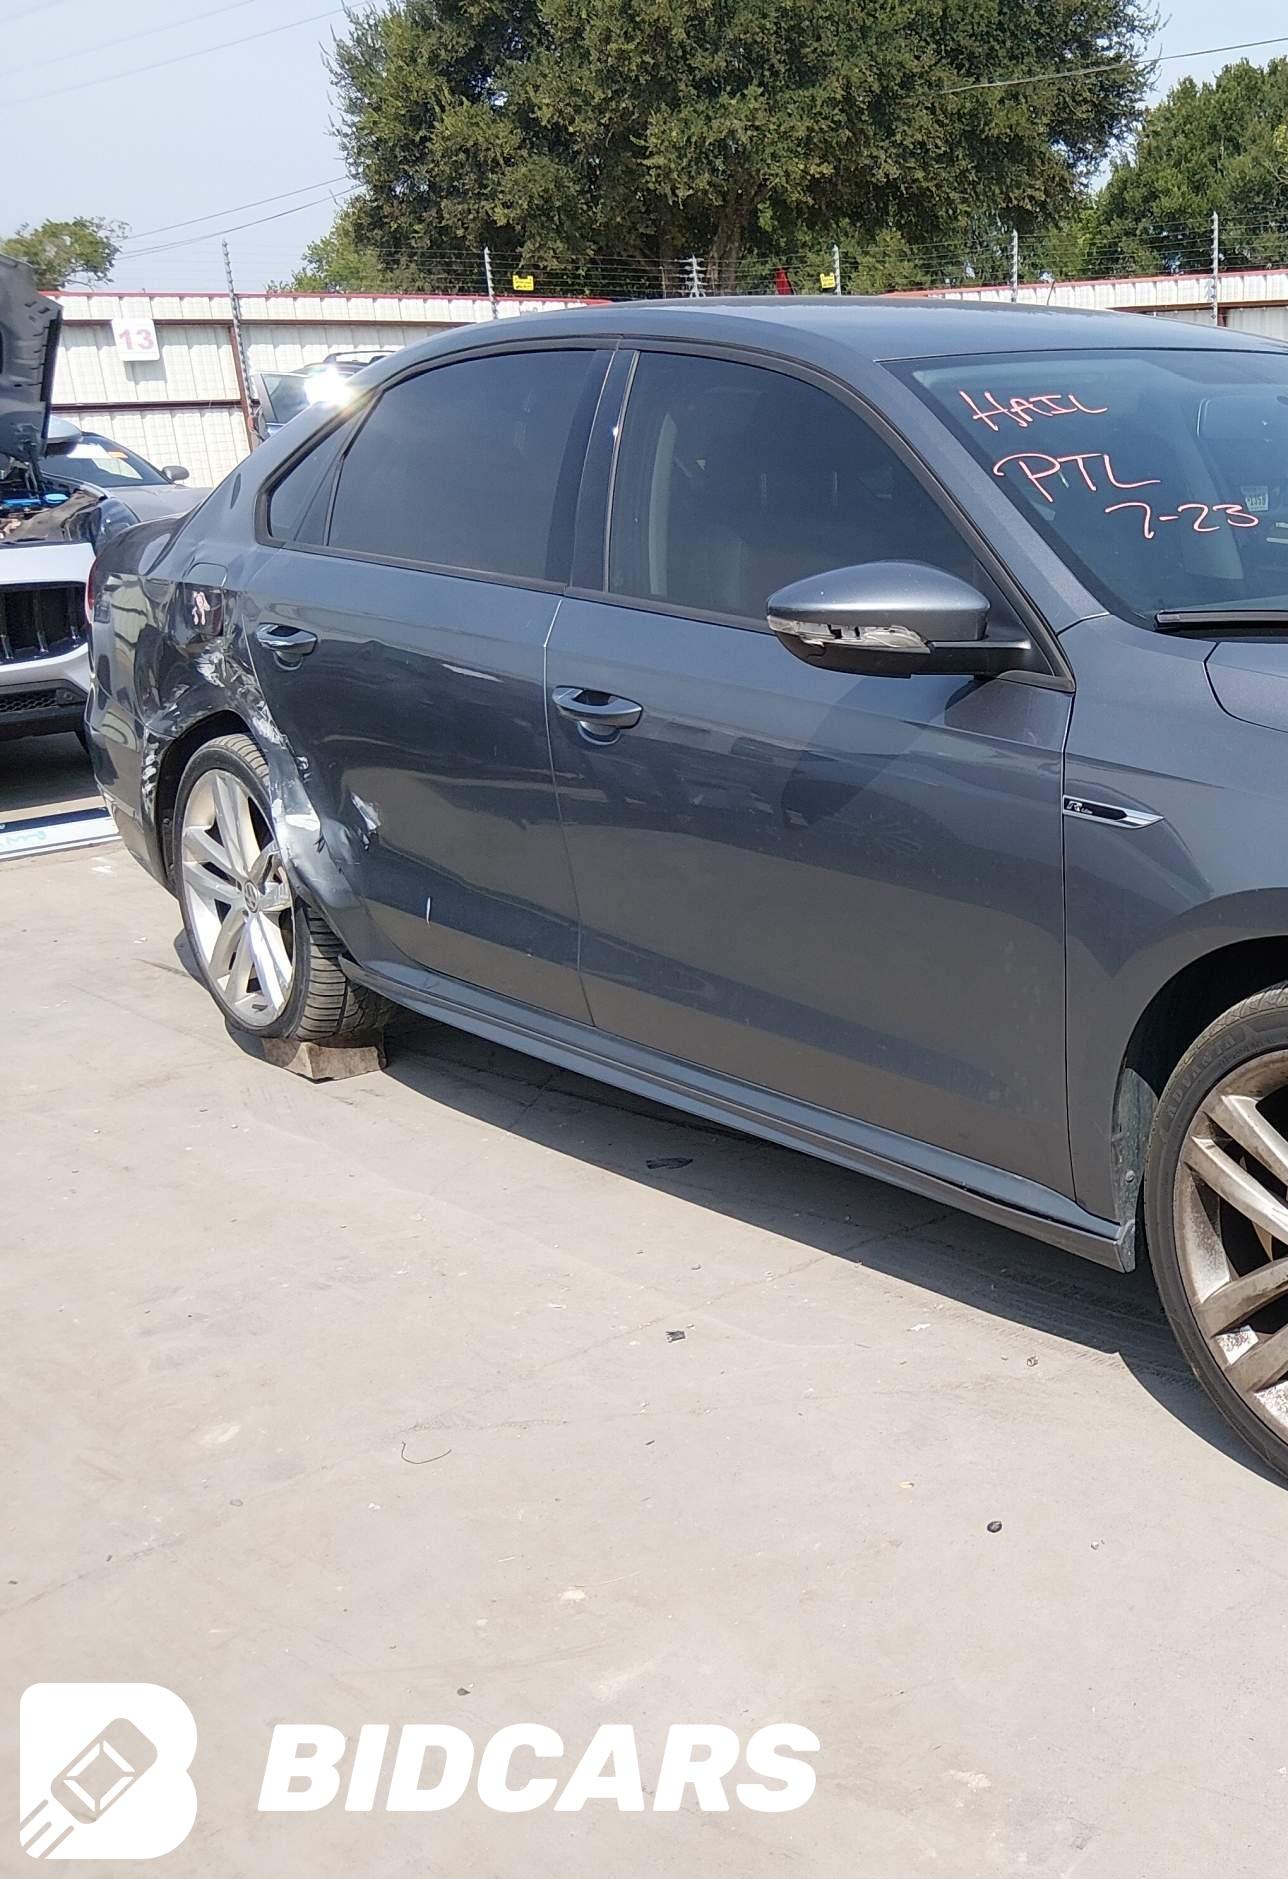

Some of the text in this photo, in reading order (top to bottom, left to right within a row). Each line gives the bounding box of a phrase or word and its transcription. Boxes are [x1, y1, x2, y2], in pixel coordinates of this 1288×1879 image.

[118, 328, 154, 350] 13
[959, 390, 1109, 432] HAIL
[993, 453, 1161, 503] PTL
[1104, 502, 1259, 539] 7-23
